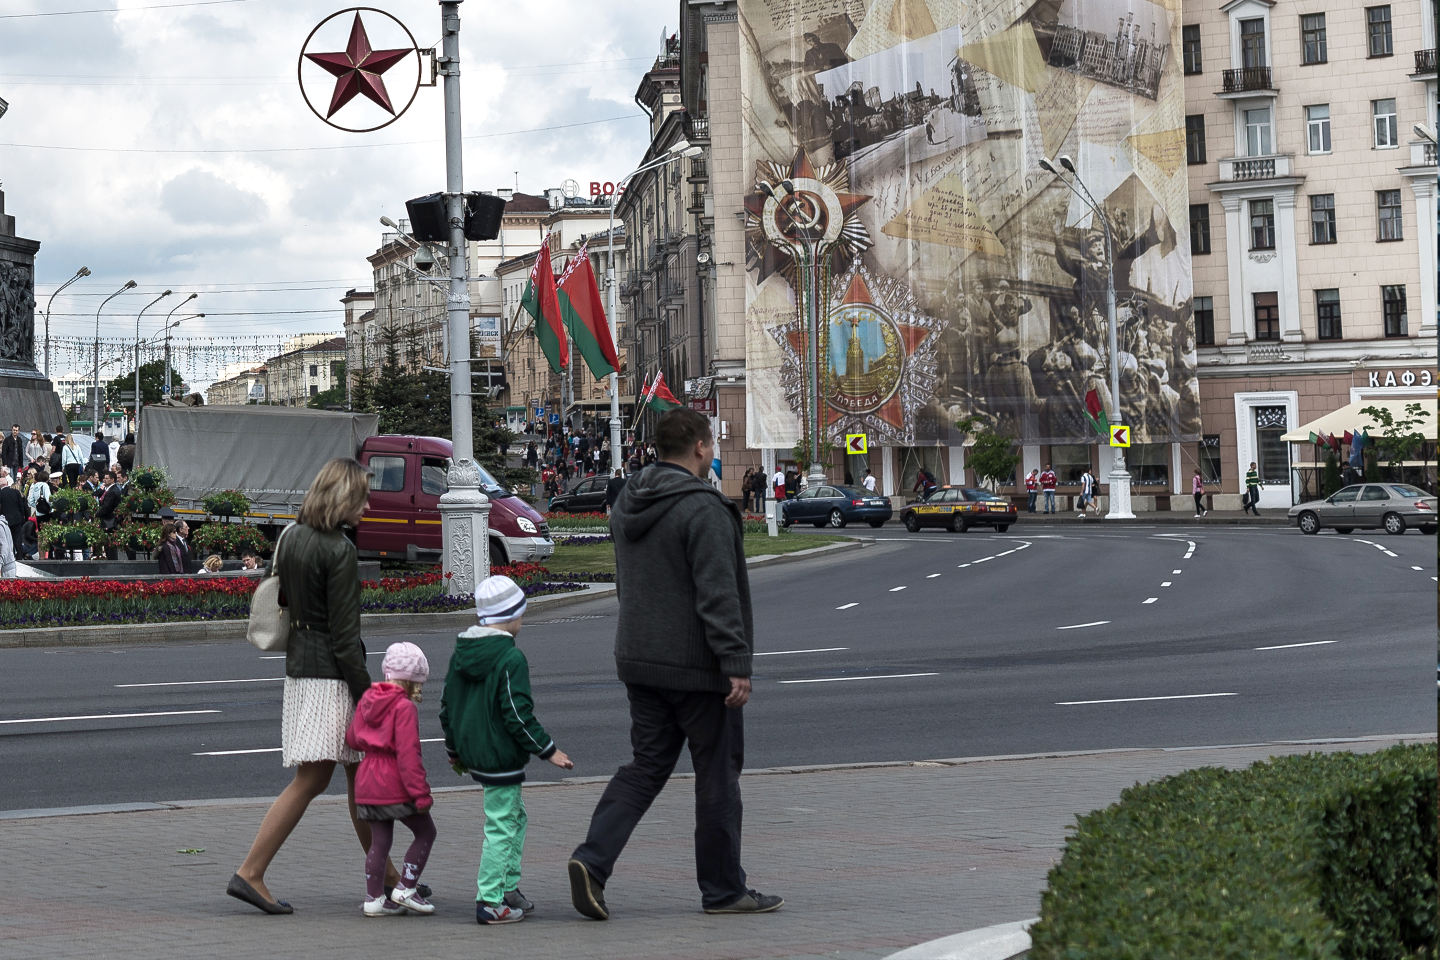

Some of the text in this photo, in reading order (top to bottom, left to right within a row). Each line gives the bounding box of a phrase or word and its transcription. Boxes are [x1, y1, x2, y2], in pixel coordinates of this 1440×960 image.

[834, 310, 877, 327] СССР
[1368, 370, 1433, 388] КАФЭ
[836, 394, 879, 408] ПОБЕДА
